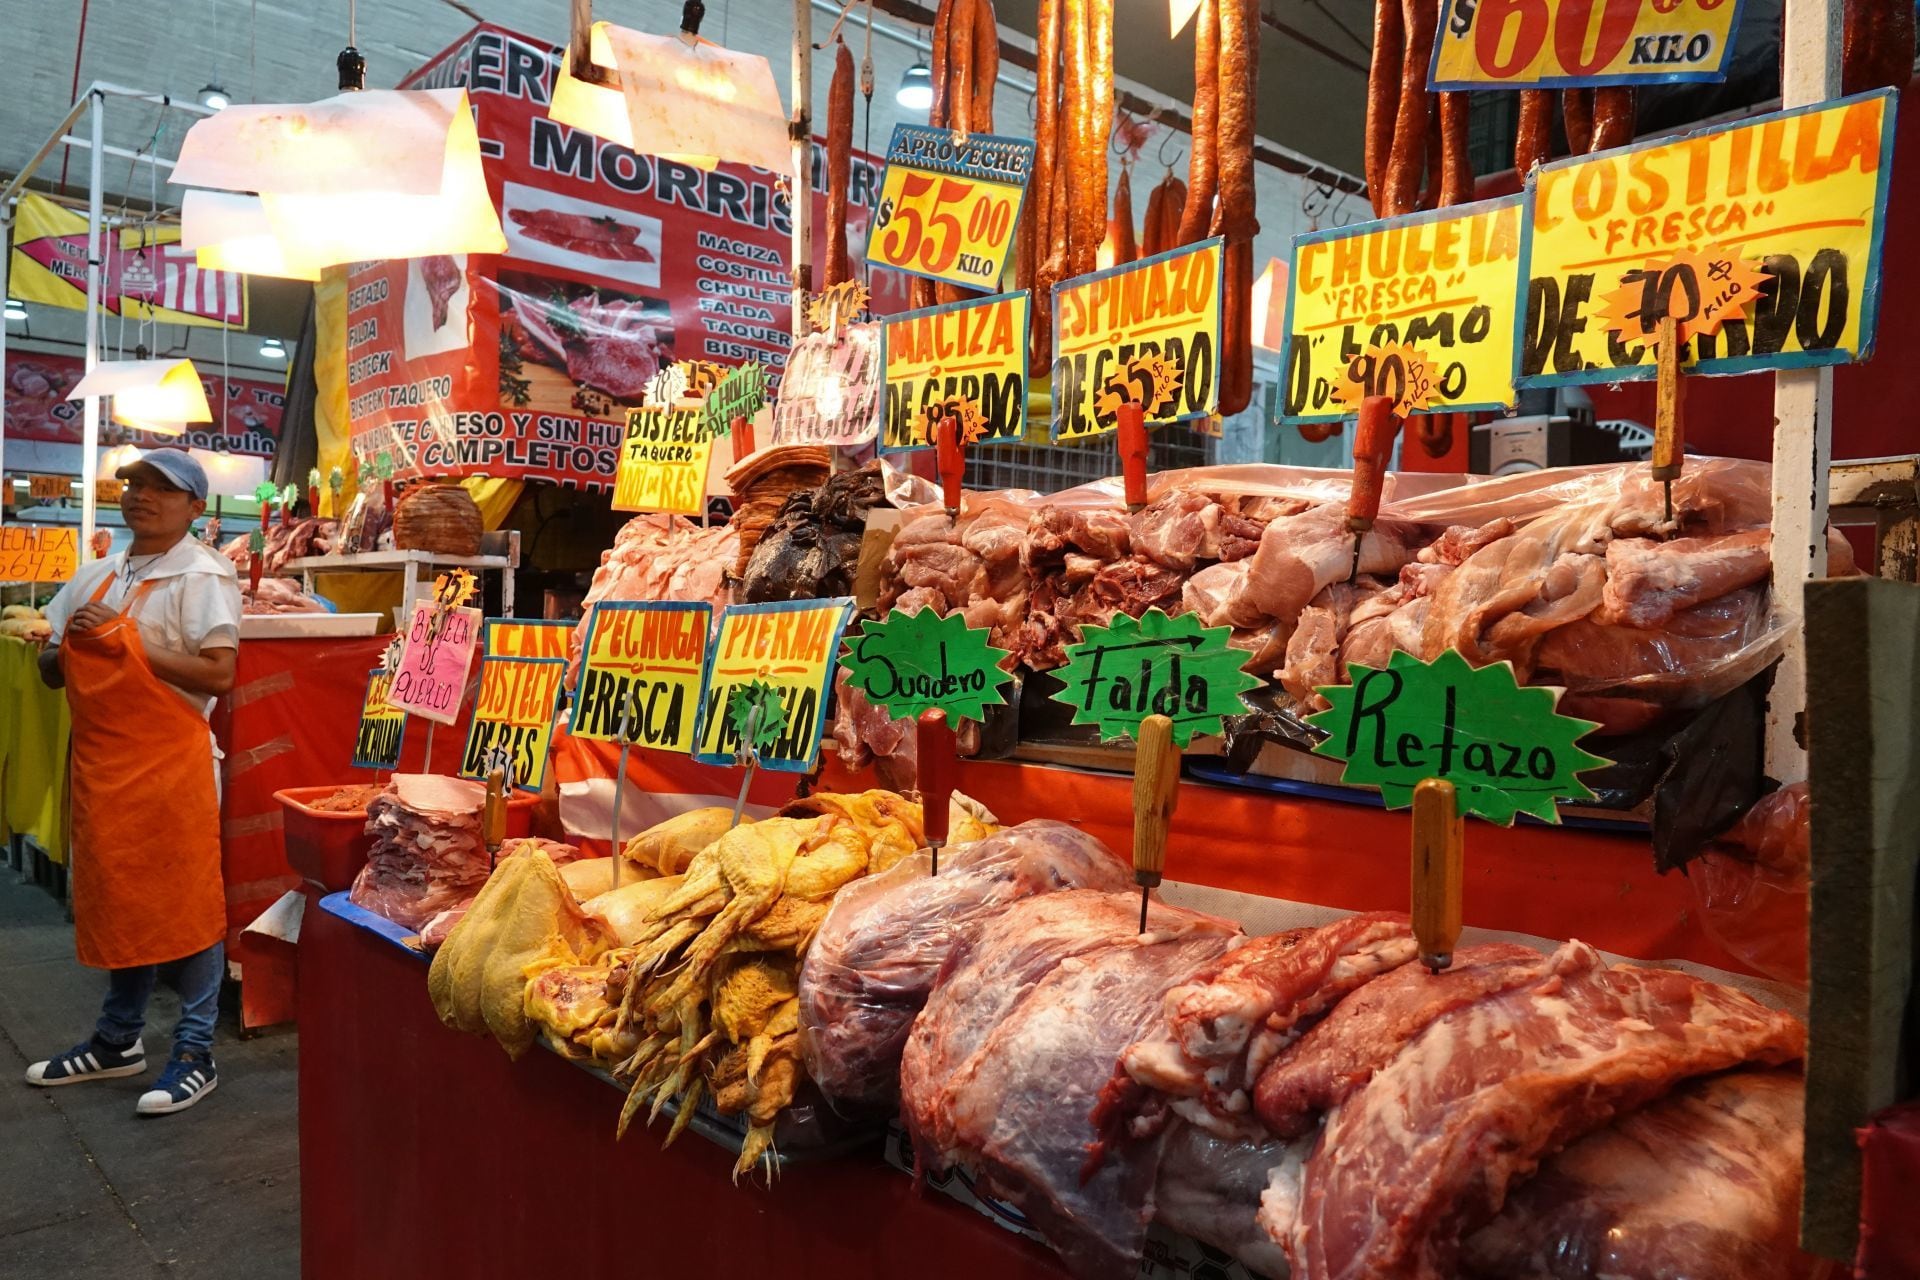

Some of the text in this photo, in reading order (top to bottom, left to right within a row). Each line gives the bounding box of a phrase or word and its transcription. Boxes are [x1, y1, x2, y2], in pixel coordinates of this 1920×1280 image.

[1629, 34, 1711, 65] KILO
[893, 135, 1026, 176] APROVECHE
[1534, 100, 1881, 233] COSTILLA
[698, 232, 782, 265] MACIZA
[956, 253, 994, 277] KILO
[349, 278, 389, 312] RETAZO
[700, 299, 774, 323] FALDA
[1059, 249, 1215, 341] ESPINAZO
[1619, 263, 1701, 335] 70
[1704, 281, 1742, 320] KILO
[349, 318, 378, 350] FALDA
[888, 300, 1014, 366] MACIZA
[349, 352, 391, 385] BISTECK
[1104, 361, 1155, 411] 55
[1155, 376, 1170, 399] KILO
[1348, 354, 1406, 408] 90
[388, 375, 452, 410] TAQUERO
[1403, 380, 1429, 407] KILO
[510, 414, 531, 436] Y
[538, 416, 580, 443] SIN
[926, 401, 964, 447] 85
[424, 438, 618, 475] COMPLETOS
[630, 444, 693, 463] TAQUERO
[659, 466, 698, 508] RES
[440, 571, 463, 606] 75
[591, 610, 706, 665] PECHUGA
[724, 607, 836, 663] PIERNA
[419, 645, 439, 676] DE
[857, 632, 985, 699] Suadero
[1075, 635, 1208, 718] Falda
[395, 671, 452, 710] PUERCO
[476, 660, 564, 724] BISTECK
[576, 668, 685, 747] FRESCA
[701, 685, 722, 748] Y
[1346, 668, 1556, 780] Retazo
